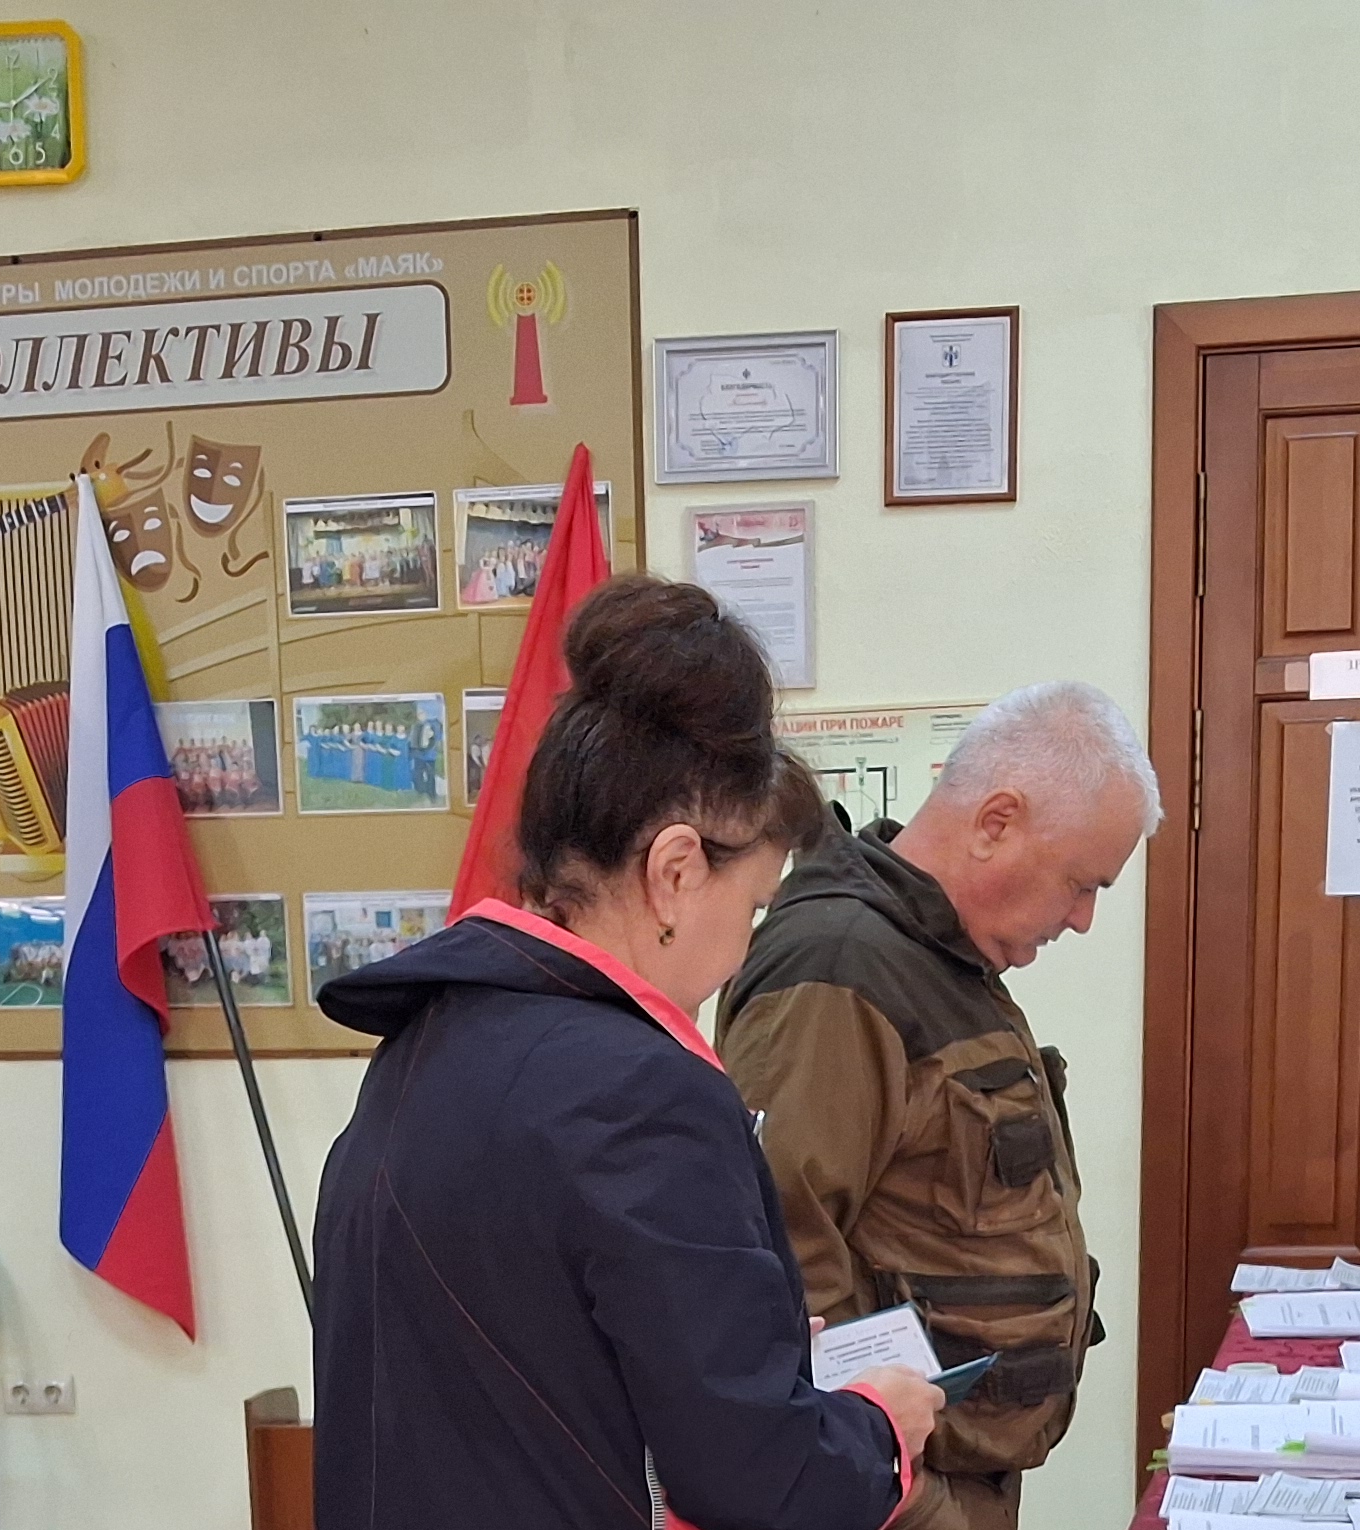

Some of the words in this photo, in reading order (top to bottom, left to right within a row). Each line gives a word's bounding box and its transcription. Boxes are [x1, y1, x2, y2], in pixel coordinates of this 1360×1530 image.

[35, 142, 46, 164] 5
[55, 268, 201, 301] МОЛОДЕЖИ
[208, 267, 226, 290] И
[233, 259, 337, 287] СПОРТА
[344, 252, 444, 281] «МАЯК»
[820, 718, 847, 731] ПРИ
[850, 715, 904, 731] ПОЖАРЕ
